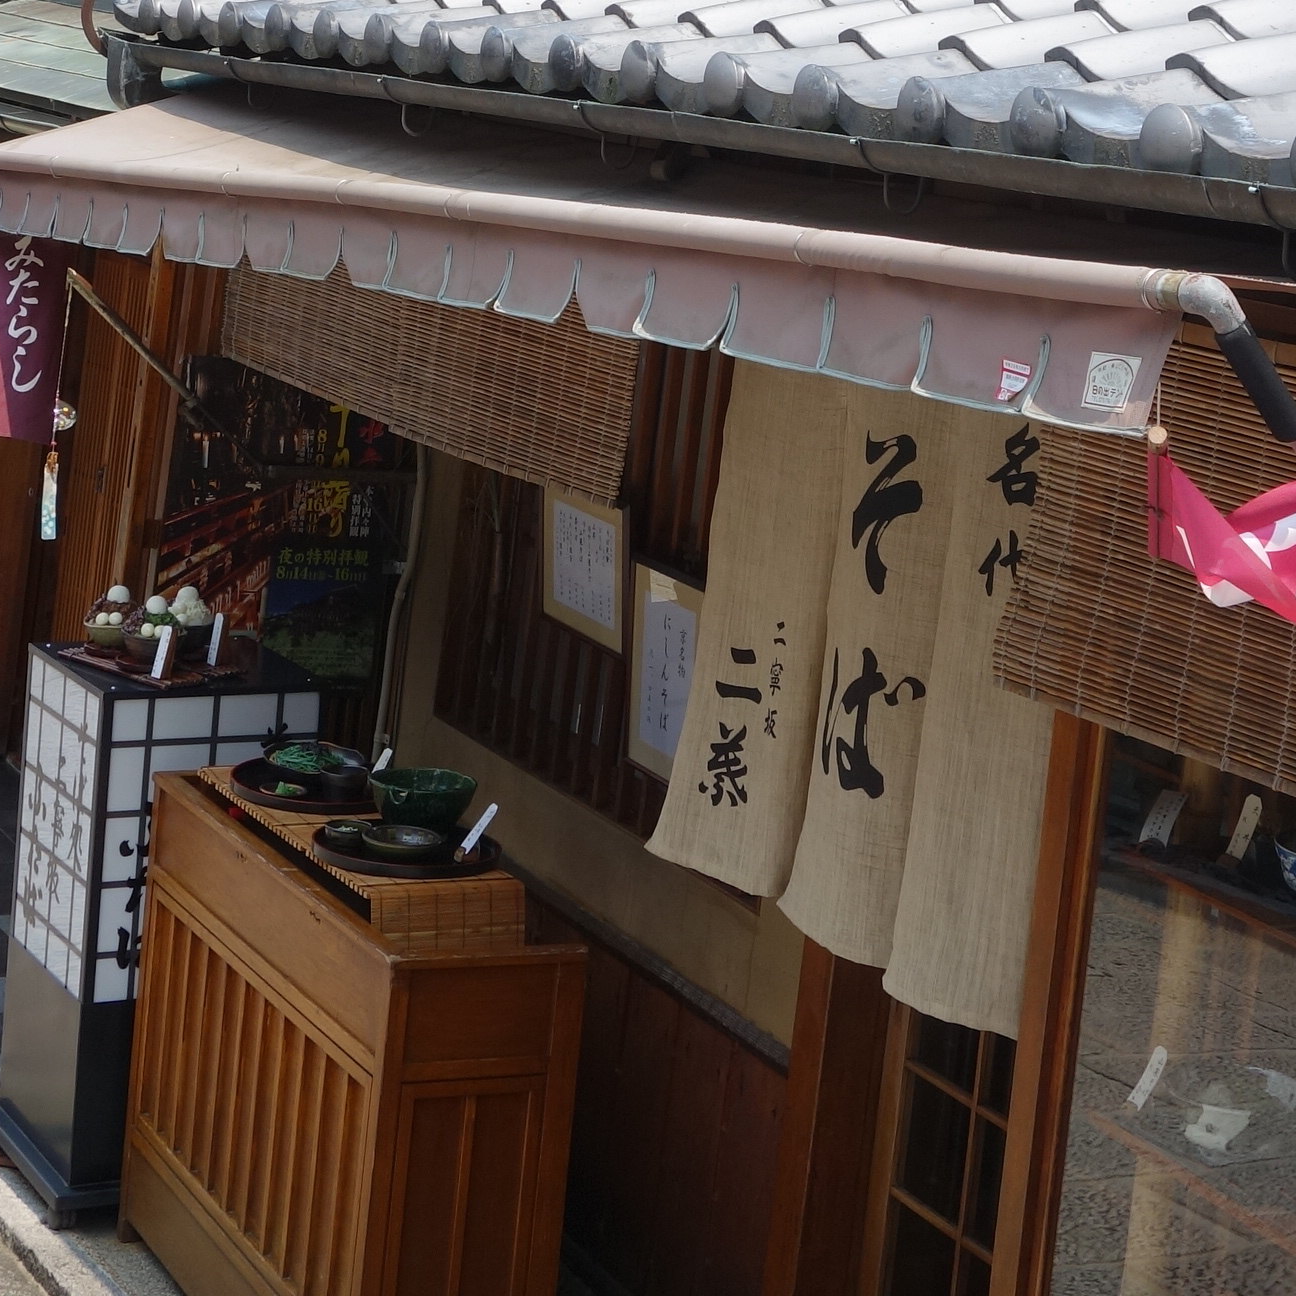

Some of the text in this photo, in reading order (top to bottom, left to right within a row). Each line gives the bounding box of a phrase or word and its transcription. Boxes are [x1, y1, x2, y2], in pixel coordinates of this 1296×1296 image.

[4, 235, 44, 394] みたらし
[821, 428, 926, 800] そば
